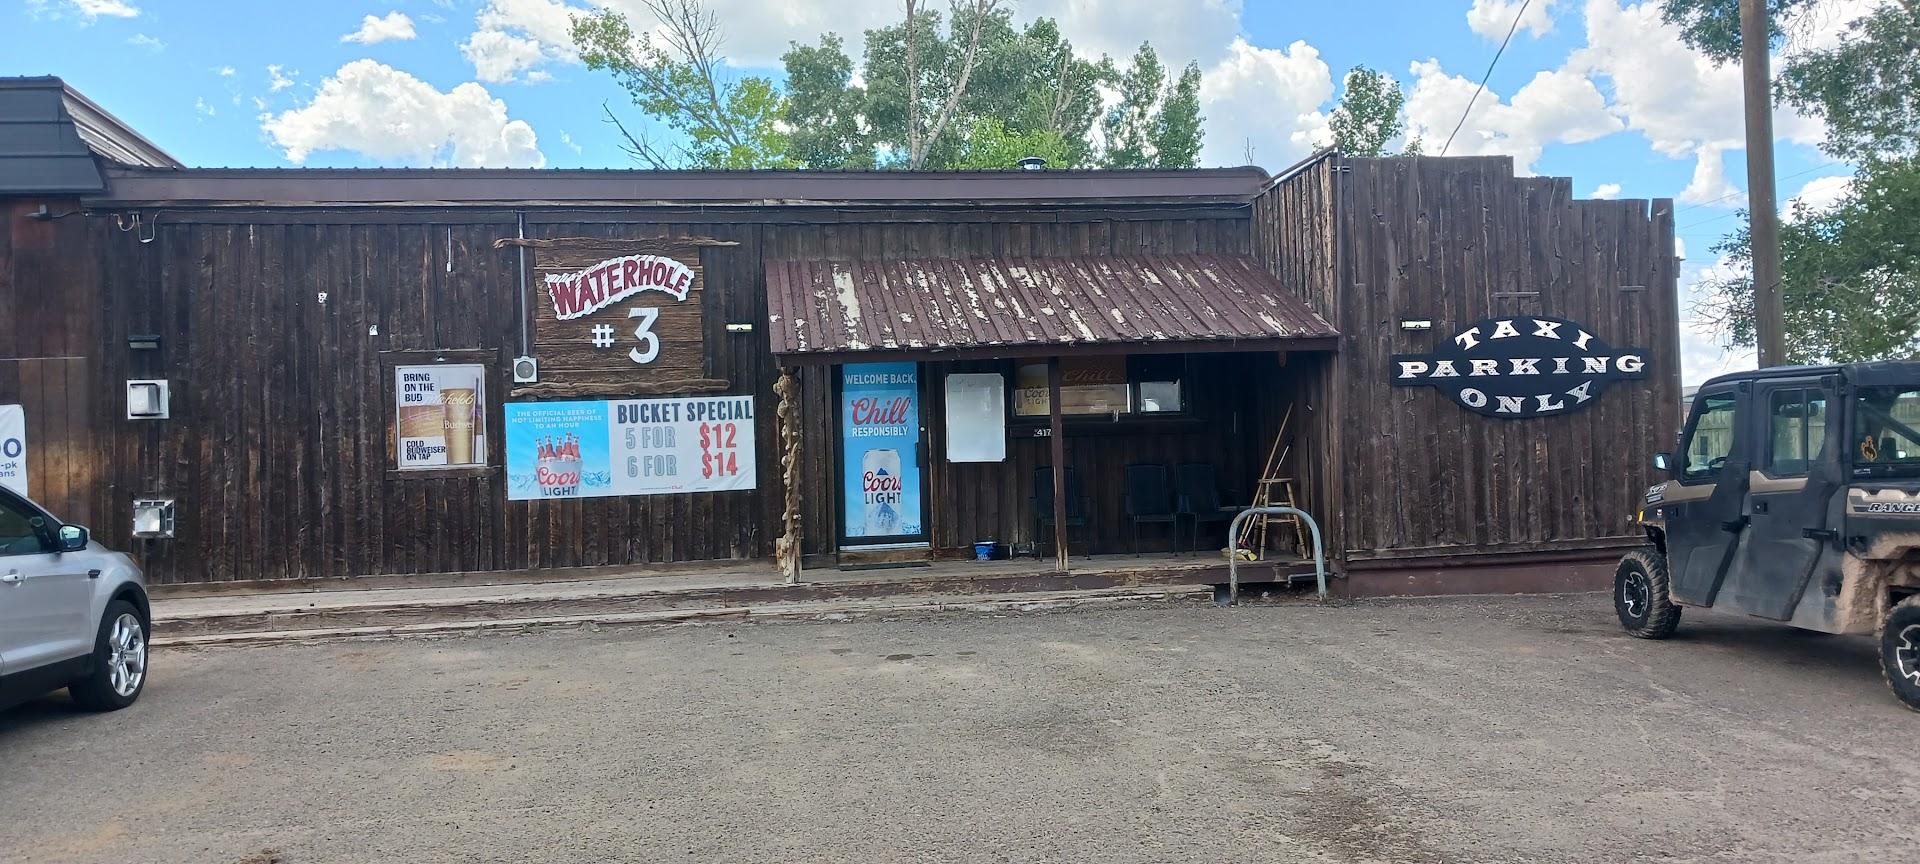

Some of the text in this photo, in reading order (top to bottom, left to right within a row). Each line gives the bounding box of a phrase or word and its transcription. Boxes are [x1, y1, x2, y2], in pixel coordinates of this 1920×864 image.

[550, 259, 689, 316] WATERHOLE
[592, 308, 659, 364] # 3
[1454, 319, 1593, 351] TAXI
[1398, 355, 1645, 378] PARKING
[403, 373, 430, 382] BRING
[844, 373, 917, 385] WELCOME BACK.
[404, 383, 435, 392] ON THE
[405, 393, 423, 402] BUD
[1460, 380, 1592, 413] ONLY
[617, 400, 753, 424] BUCKET SPECIAL
[851, 396, 912, 425] Chill
[626, 422, 737, 450] 5 FOR $12
[852, 426, 908, 437] RESPONSIBLY
[406, 446, 446, 454] BUDWEISER
[406, 453, 431, 461] ON TAP
[627, 450, 738, 479] 6 FOR $14
[543, 486, 577, 496] LIGHT
[865, 493, 901, 504] LIGHT
